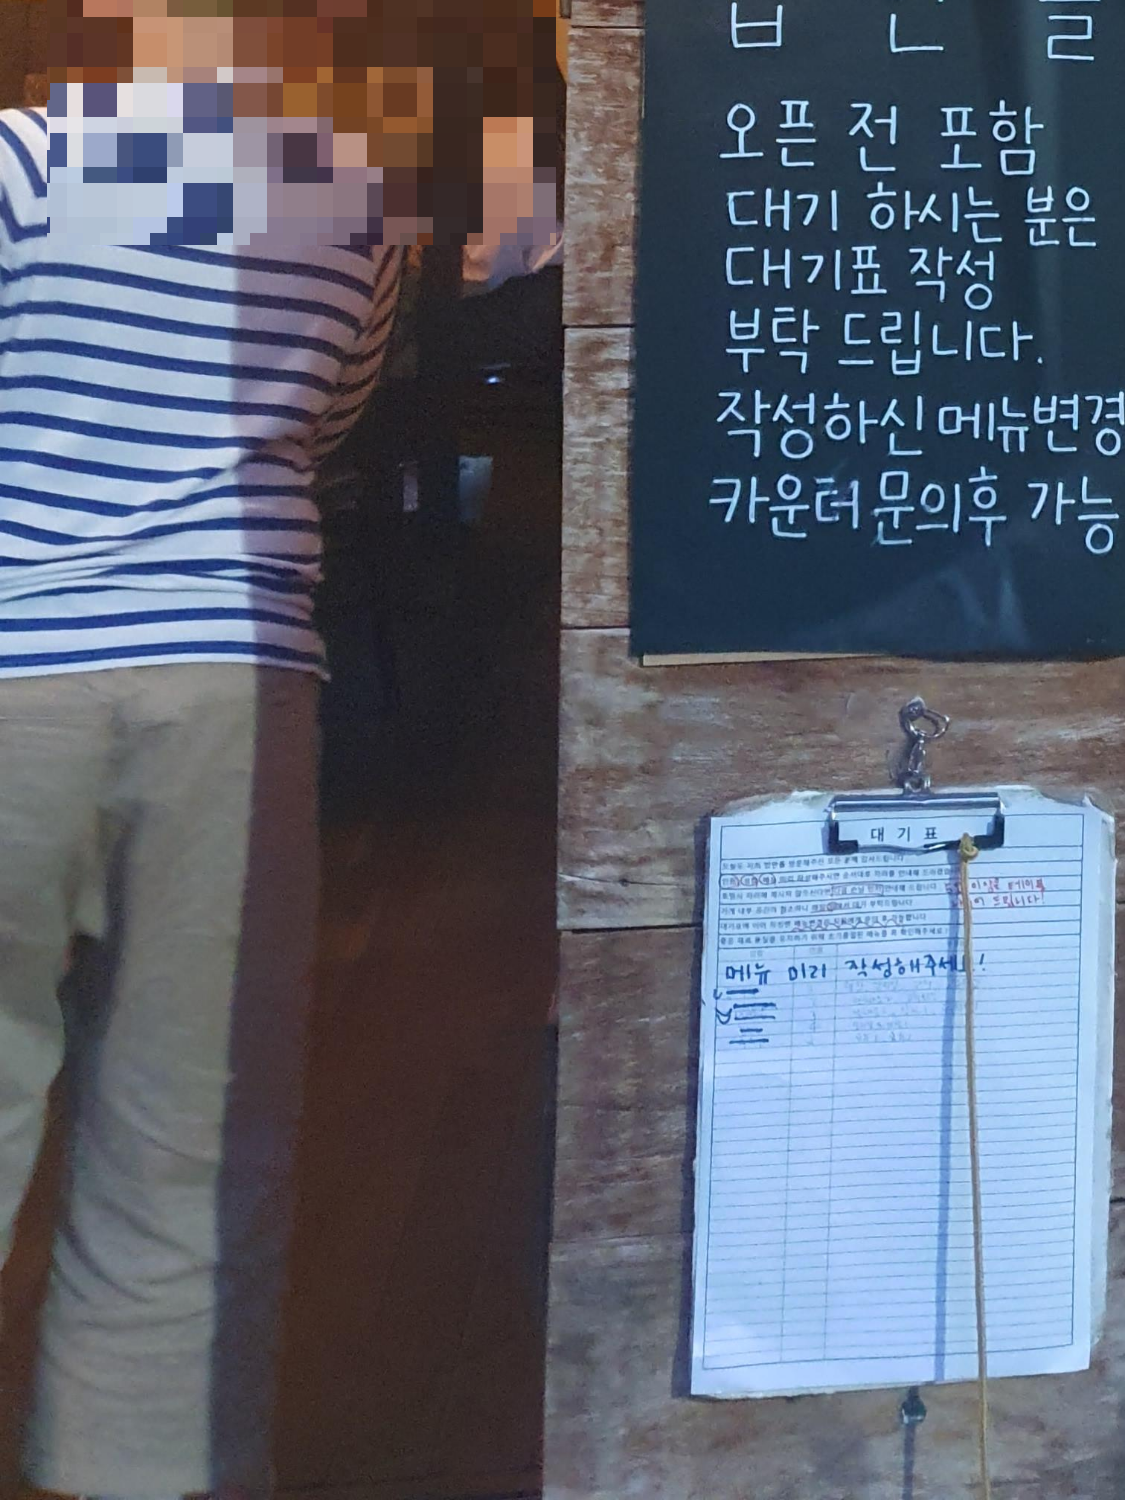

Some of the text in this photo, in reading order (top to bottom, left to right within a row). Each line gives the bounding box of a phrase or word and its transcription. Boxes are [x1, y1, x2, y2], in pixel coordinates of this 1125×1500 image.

[719, 99, 1045, 176] 오픈 전 포함
[726, 182, 1097, 247] 대기 하시는 분은
[725, 245, 996, 310] 대기표 작성
[725, 306, 1044, 375] 부탁 드립니다.
[1026, 474, 1120, 555] 가능
[725, 962, 772, 986] 메뉴
[788, 962, 828, 981] 미리
